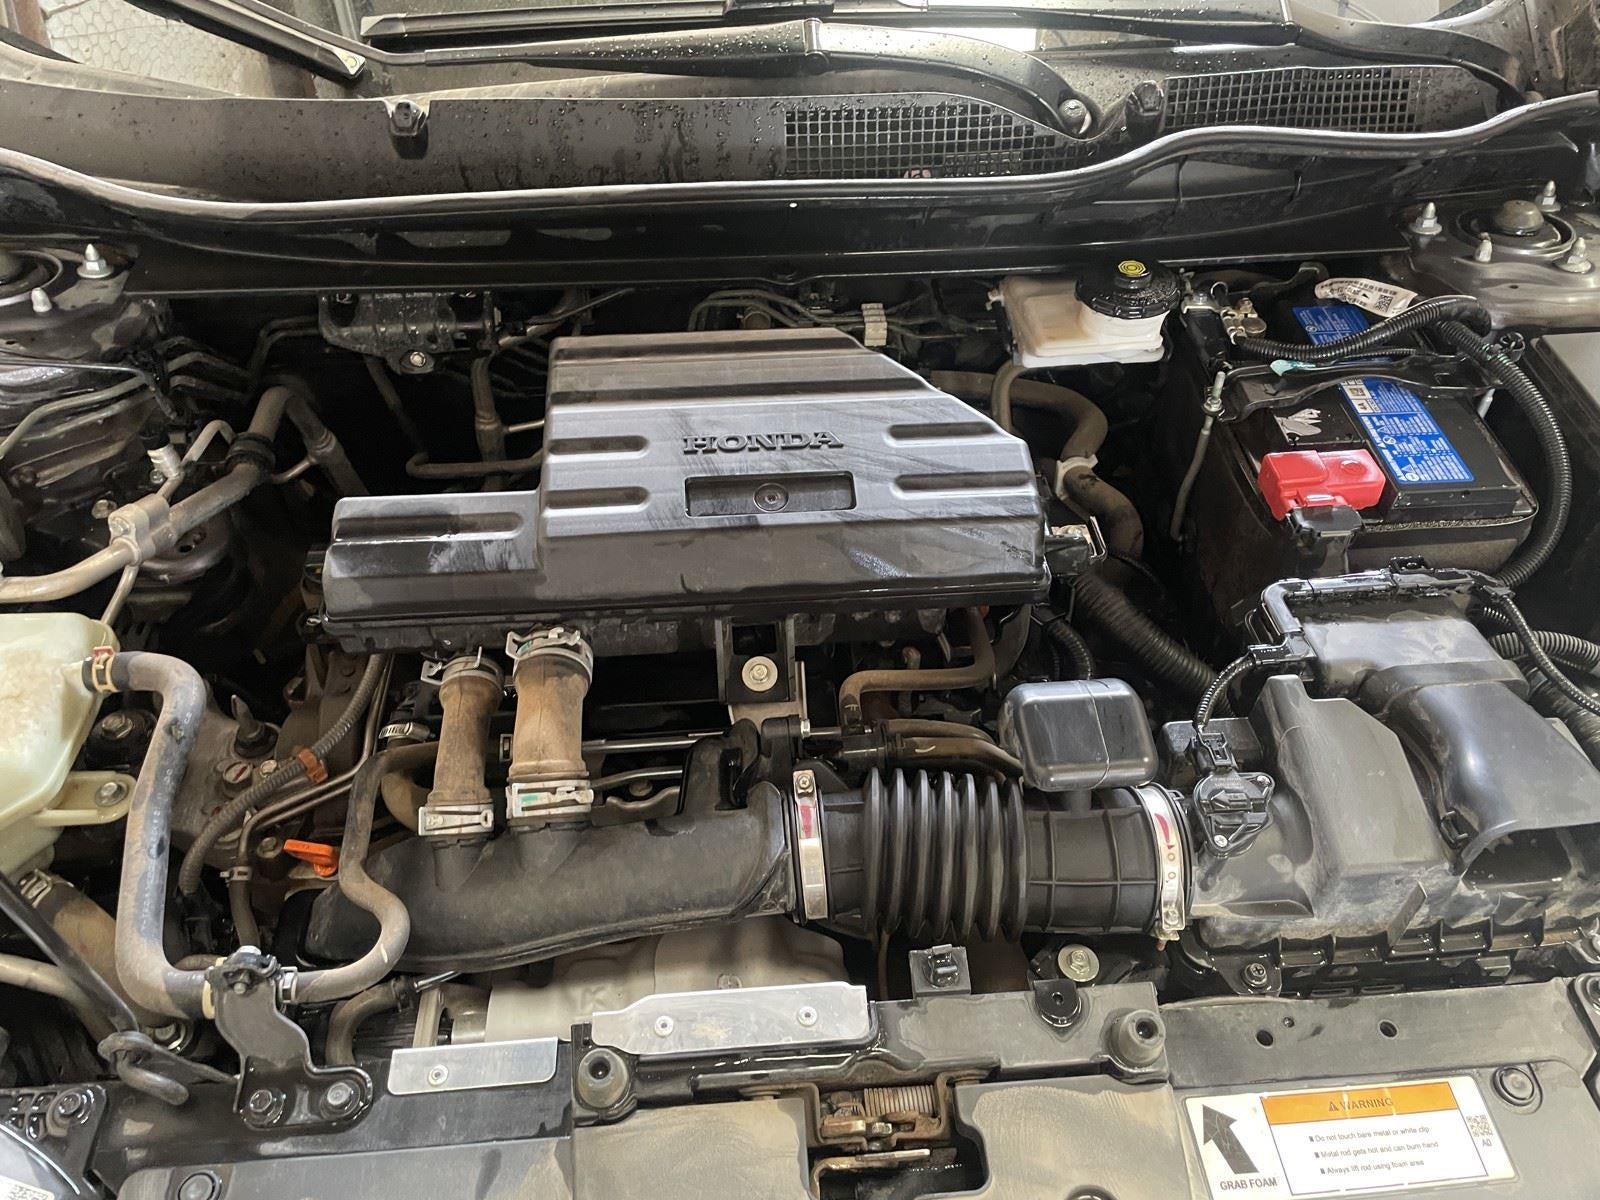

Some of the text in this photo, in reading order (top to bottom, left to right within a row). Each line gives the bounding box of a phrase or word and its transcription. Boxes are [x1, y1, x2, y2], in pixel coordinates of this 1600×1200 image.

[683, 431, 844, 455] HONDA
[1340, 1098, 1393, 1110] WARNING
[1314, 1134, 1325, 1142] Do
[1326, 1133, 1336, 1141] not
[1338, 1132, 1355, 1140] touch
[1373, 1129, 1391, 1137] metal
[1418, 1126, 1430, 1134] clip
[1320, 1150, 1339, 1158] Metal
[1352, 1149, 1367, 1157] gets
[1367, 1146, 1378, 1154] hot
[1379, 1145, 1392, 1153] and
[1406, 1143, 1421, 1151] burn
[1422, 1141, 1439, 1149] hand
[1373, 1162, 1391, 1170] using
[1392, 1161, 1408, 1169] foam
[1219, 1177, 1278, 1191] GRAB FOAM
